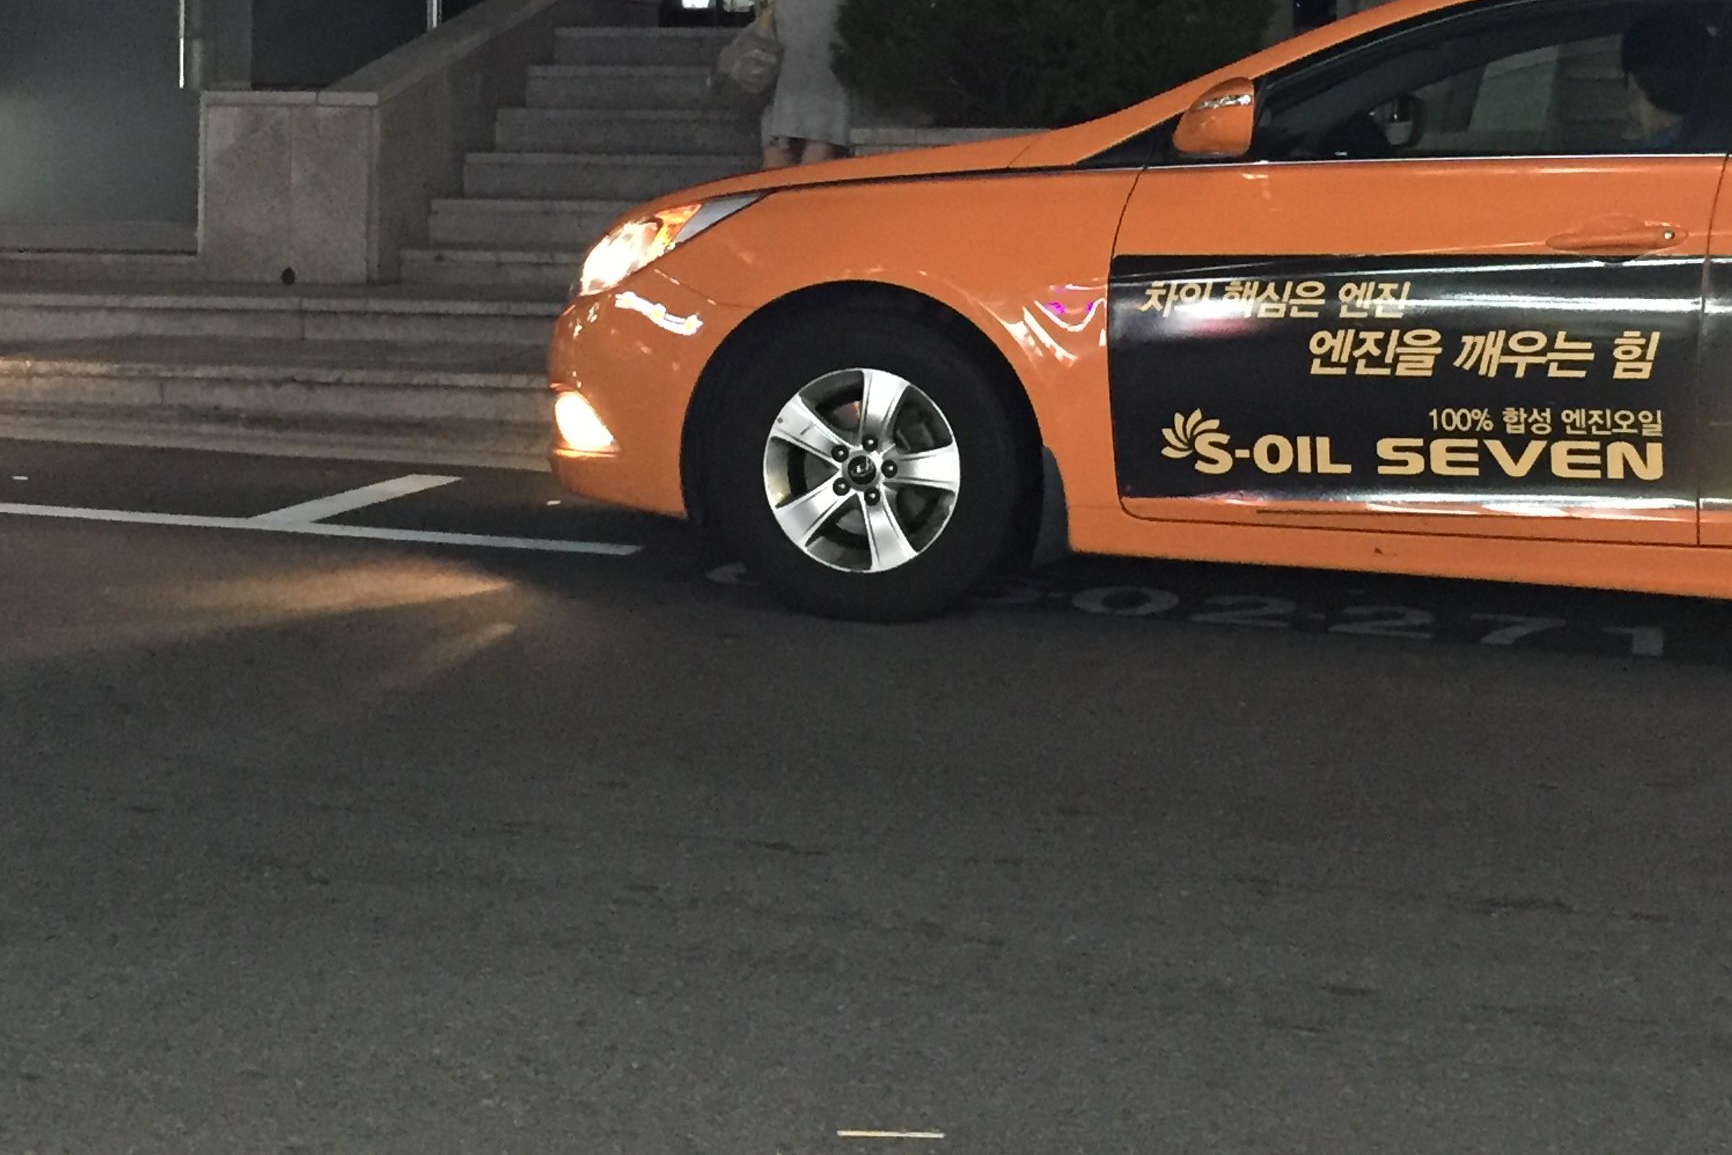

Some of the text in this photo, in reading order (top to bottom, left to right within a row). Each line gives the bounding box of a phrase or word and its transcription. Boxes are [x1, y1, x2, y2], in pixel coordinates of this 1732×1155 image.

[1223, 280, 1326, 319] 핵심은
[1337, 280, 1412, 320] 엔진
[1308, 328, 1662, 381] 엔진을 깨우는 힘
[1428, 407, 1665, 439] 100% 합성 엔진오일
[1193, 429, 1665, 481] S-OIL SEVEN
